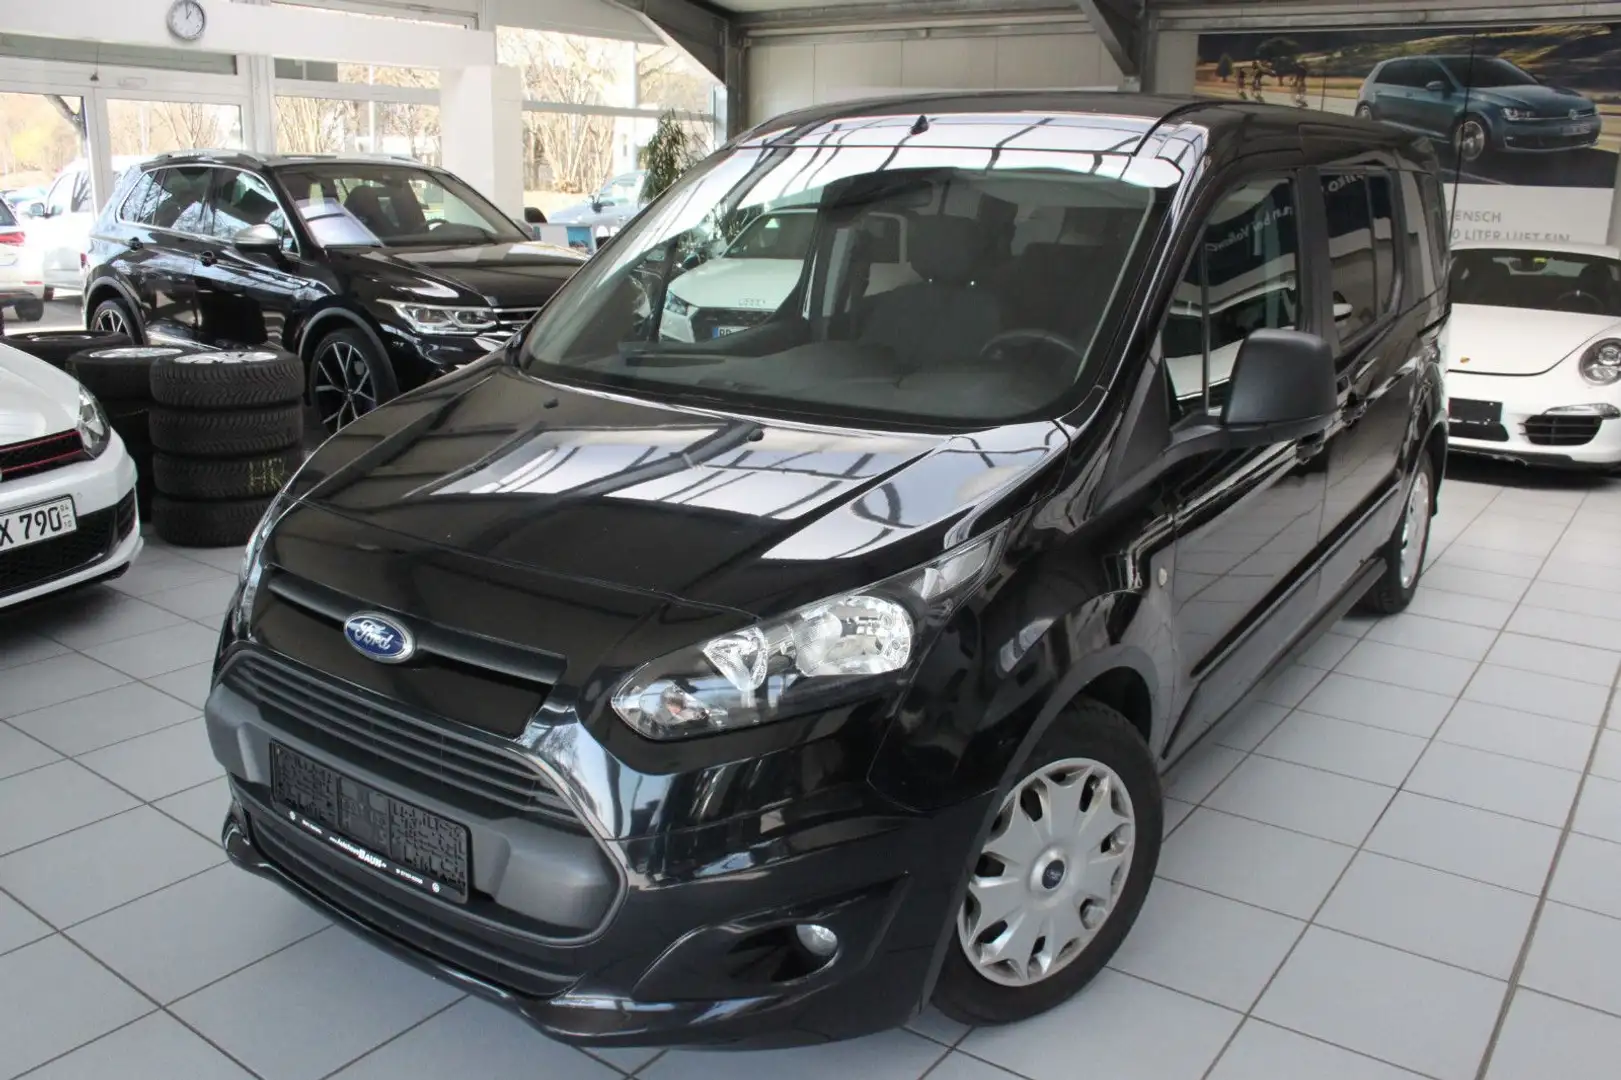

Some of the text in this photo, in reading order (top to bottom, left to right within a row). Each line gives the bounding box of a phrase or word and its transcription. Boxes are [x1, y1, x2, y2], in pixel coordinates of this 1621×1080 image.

[1447, 210, 1502, 224] ENSCH
[18, 506, 63, 540] 790
[354, 619, 395, 651] Ford
